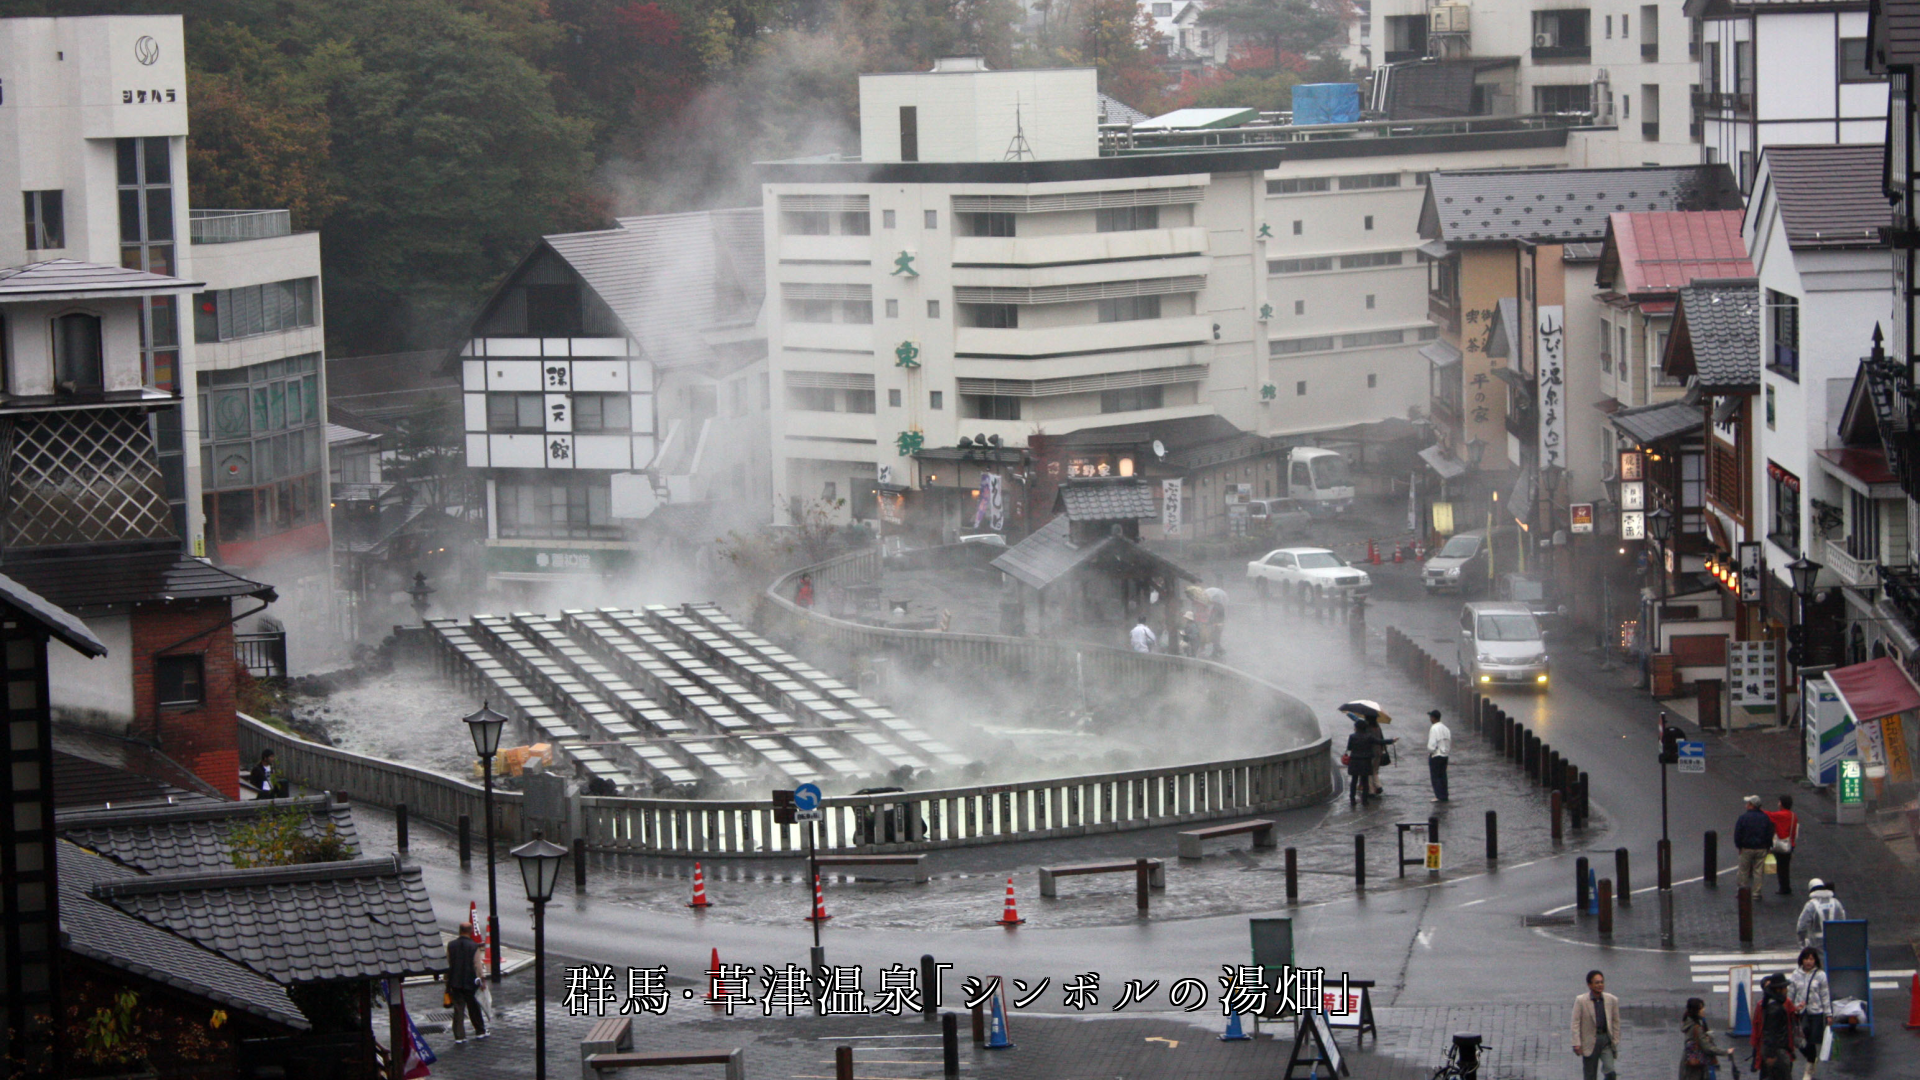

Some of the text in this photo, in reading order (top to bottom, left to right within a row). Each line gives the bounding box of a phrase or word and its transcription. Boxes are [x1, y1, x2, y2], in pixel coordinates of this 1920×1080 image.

[889, 250, 925, 457] 大東館
[1256, 222, 1277, 399] 大東館
[1469, 372, 1490, 423] 平の家
[1842, 760, 1860, 778] 酒
